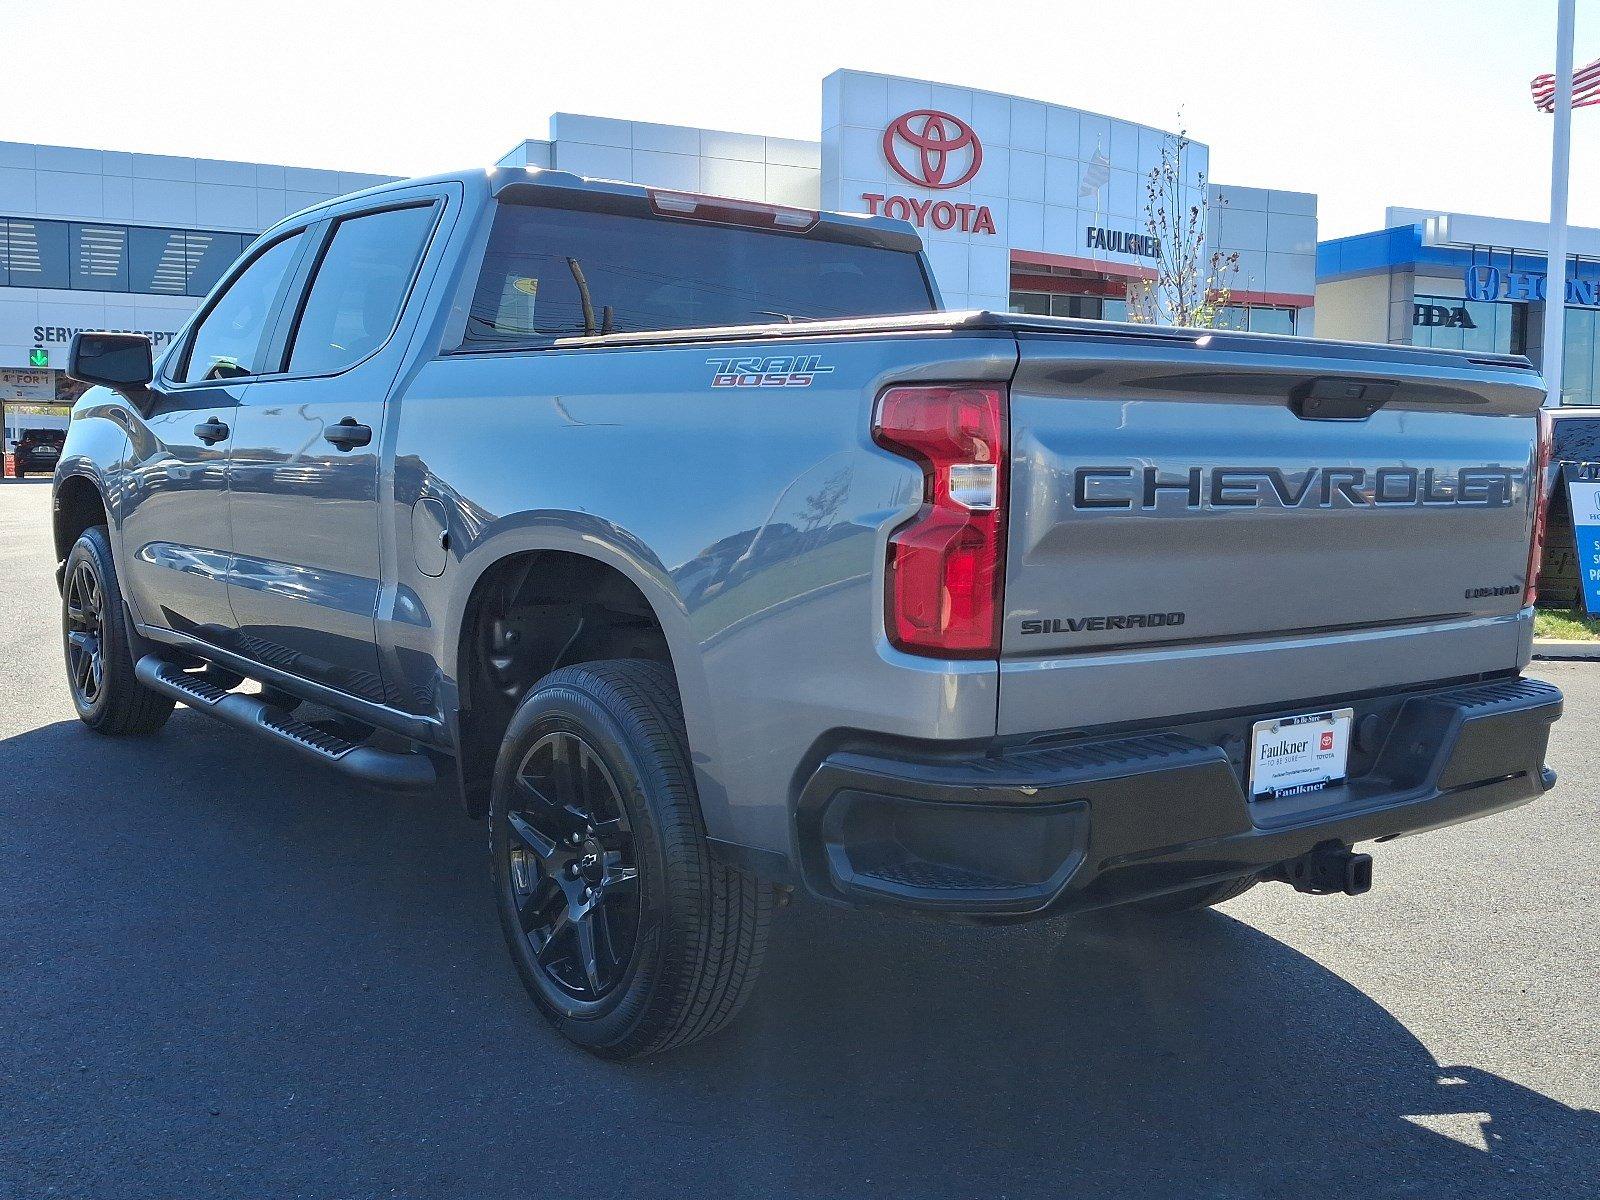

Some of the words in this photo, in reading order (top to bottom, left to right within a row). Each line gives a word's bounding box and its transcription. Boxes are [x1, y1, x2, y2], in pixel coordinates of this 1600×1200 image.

[862, 192, 997, 235] TOYOTA
[1086, 226, 1161, 258] FAULKNER
[706, 355, 835, 374] TRAIL
[711, 372, 815, 388] BOSS
[1073, 466, 1525, 511] CHEVROLET
[1020, 611, 1185, 635] SILVERADO
[1260, 740, 1308, 760] Faulkner
[1284, 755, 1299, 764] SURE
[1316, 752, 1335, 760] TOYOTA
[1275, 782, 1327, 798] Faulkner
